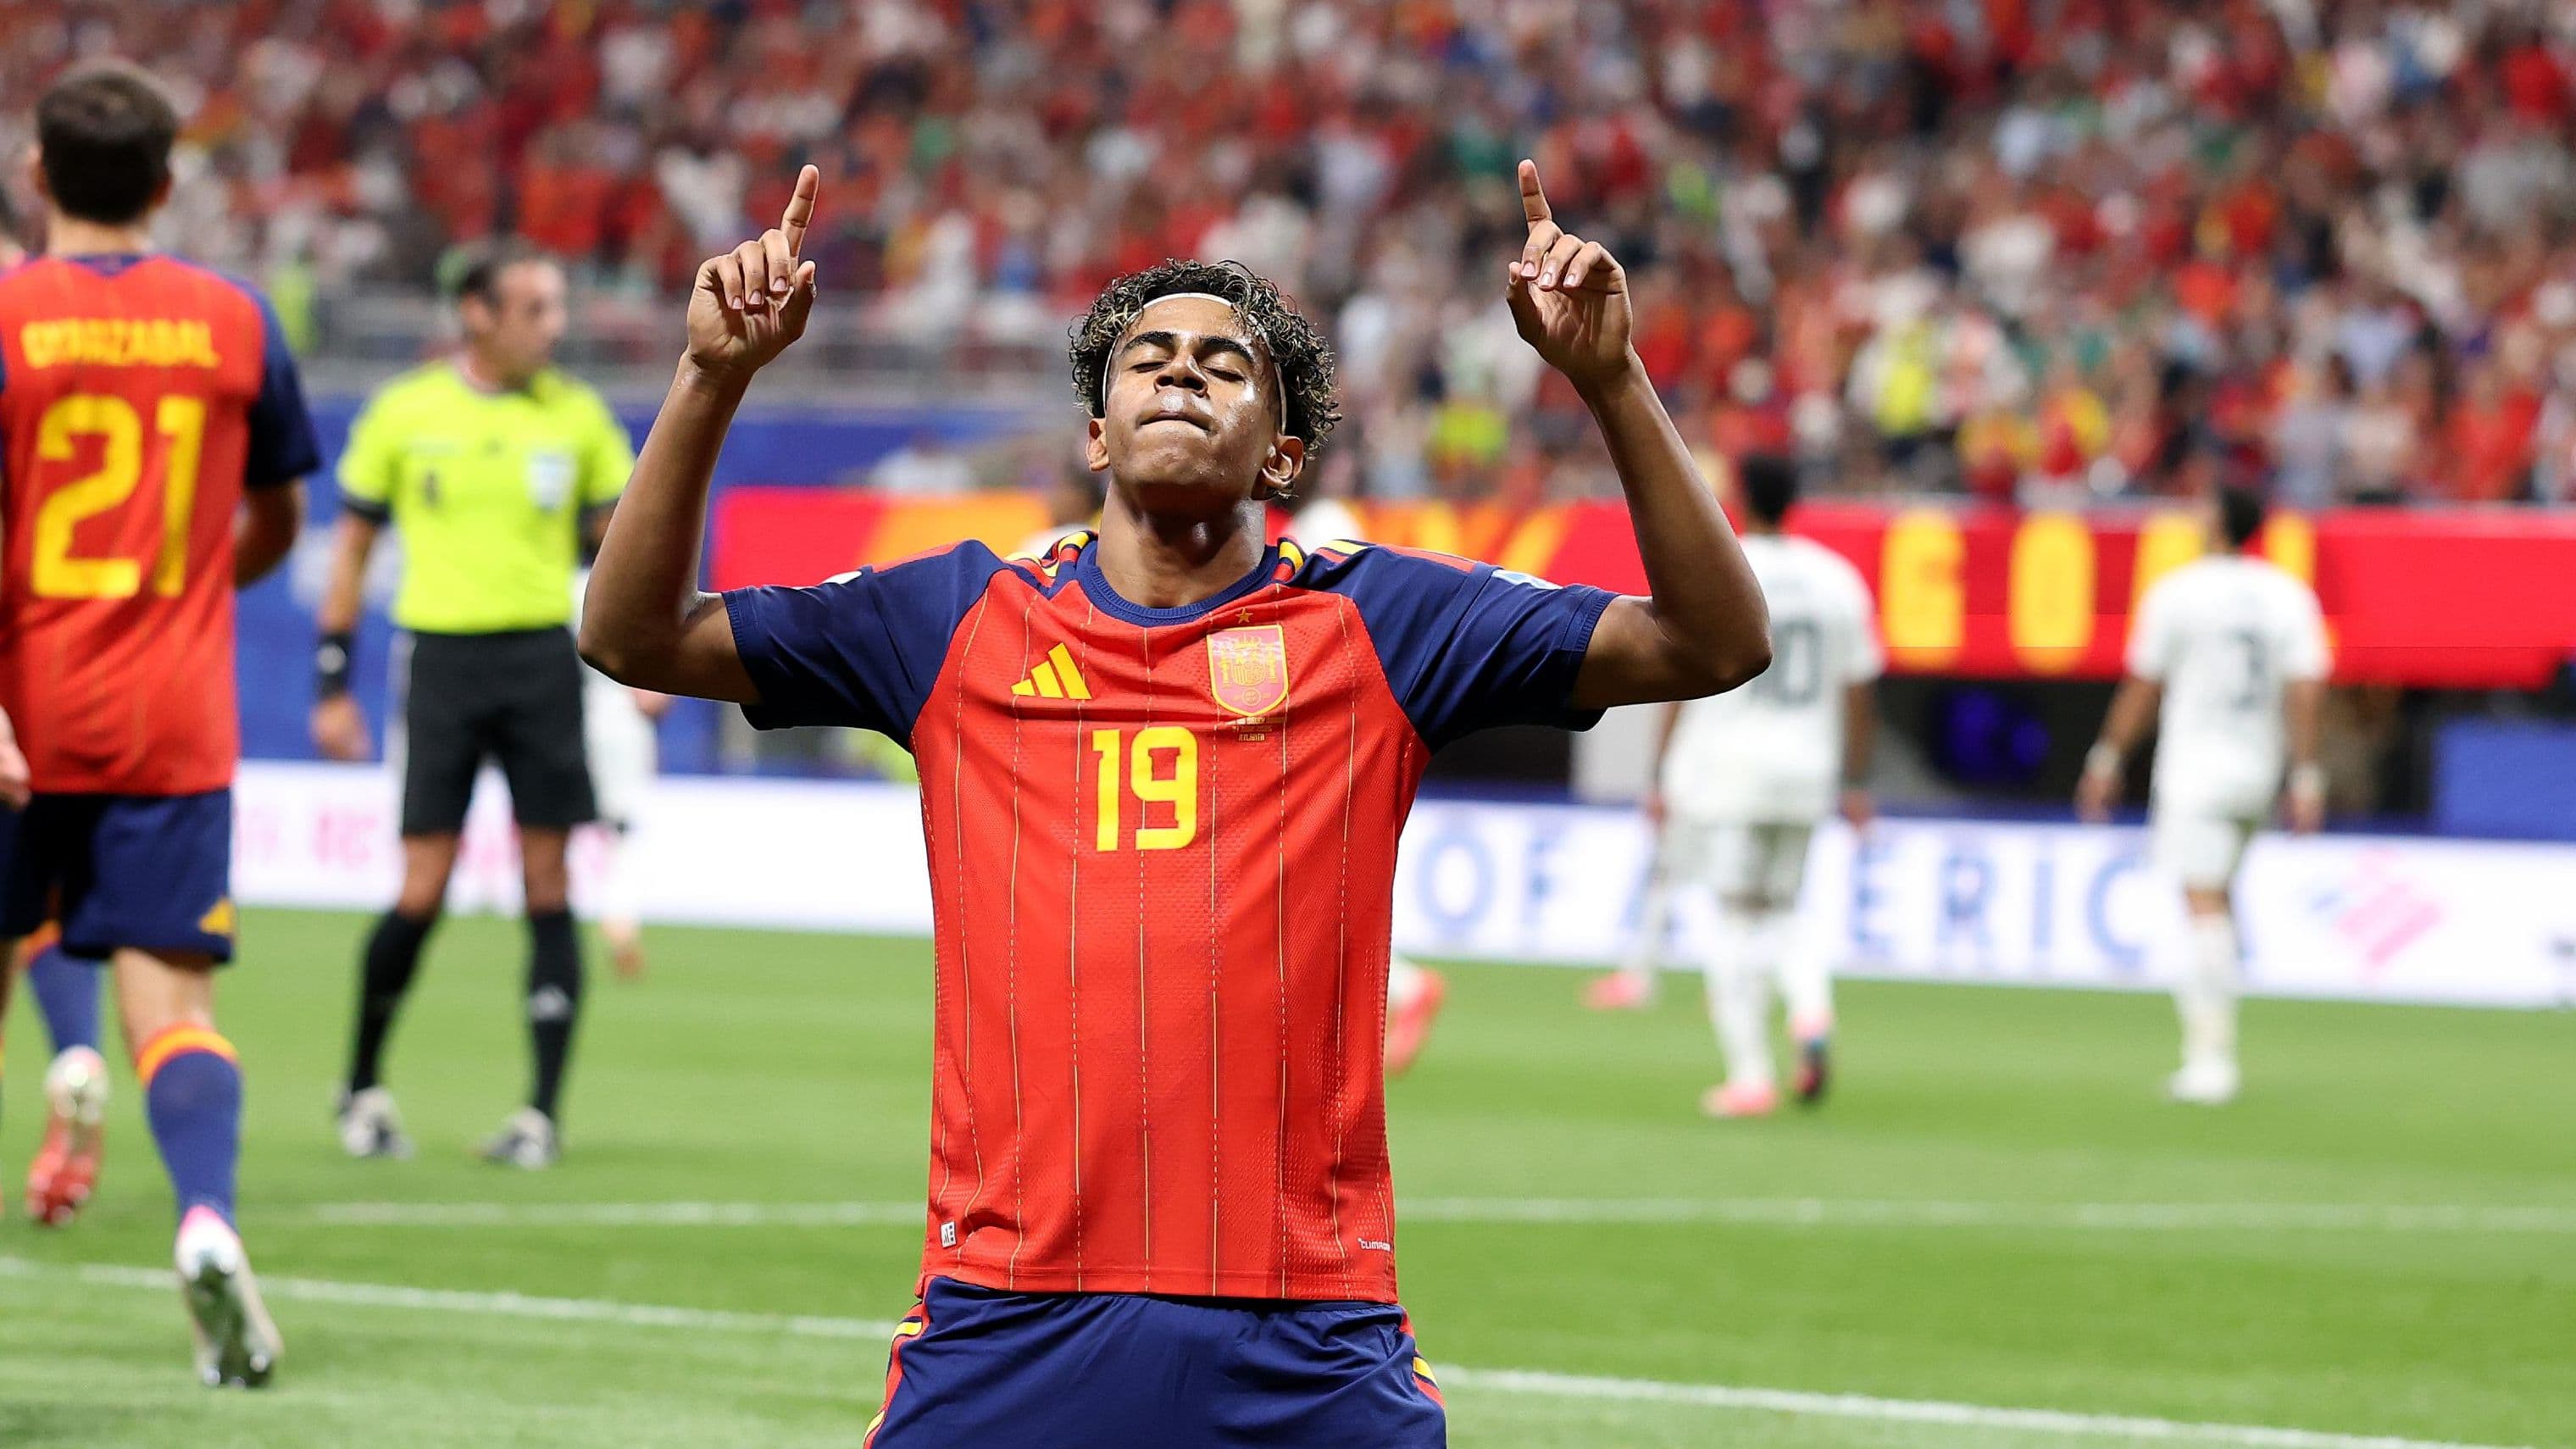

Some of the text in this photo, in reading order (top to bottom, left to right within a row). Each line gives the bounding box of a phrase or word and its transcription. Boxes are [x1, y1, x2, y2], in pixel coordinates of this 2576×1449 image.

[34, 395, 204, 597] 21
[1092, 725, 1198, 852] 19
[1417, 824, 1569, 932] OF
